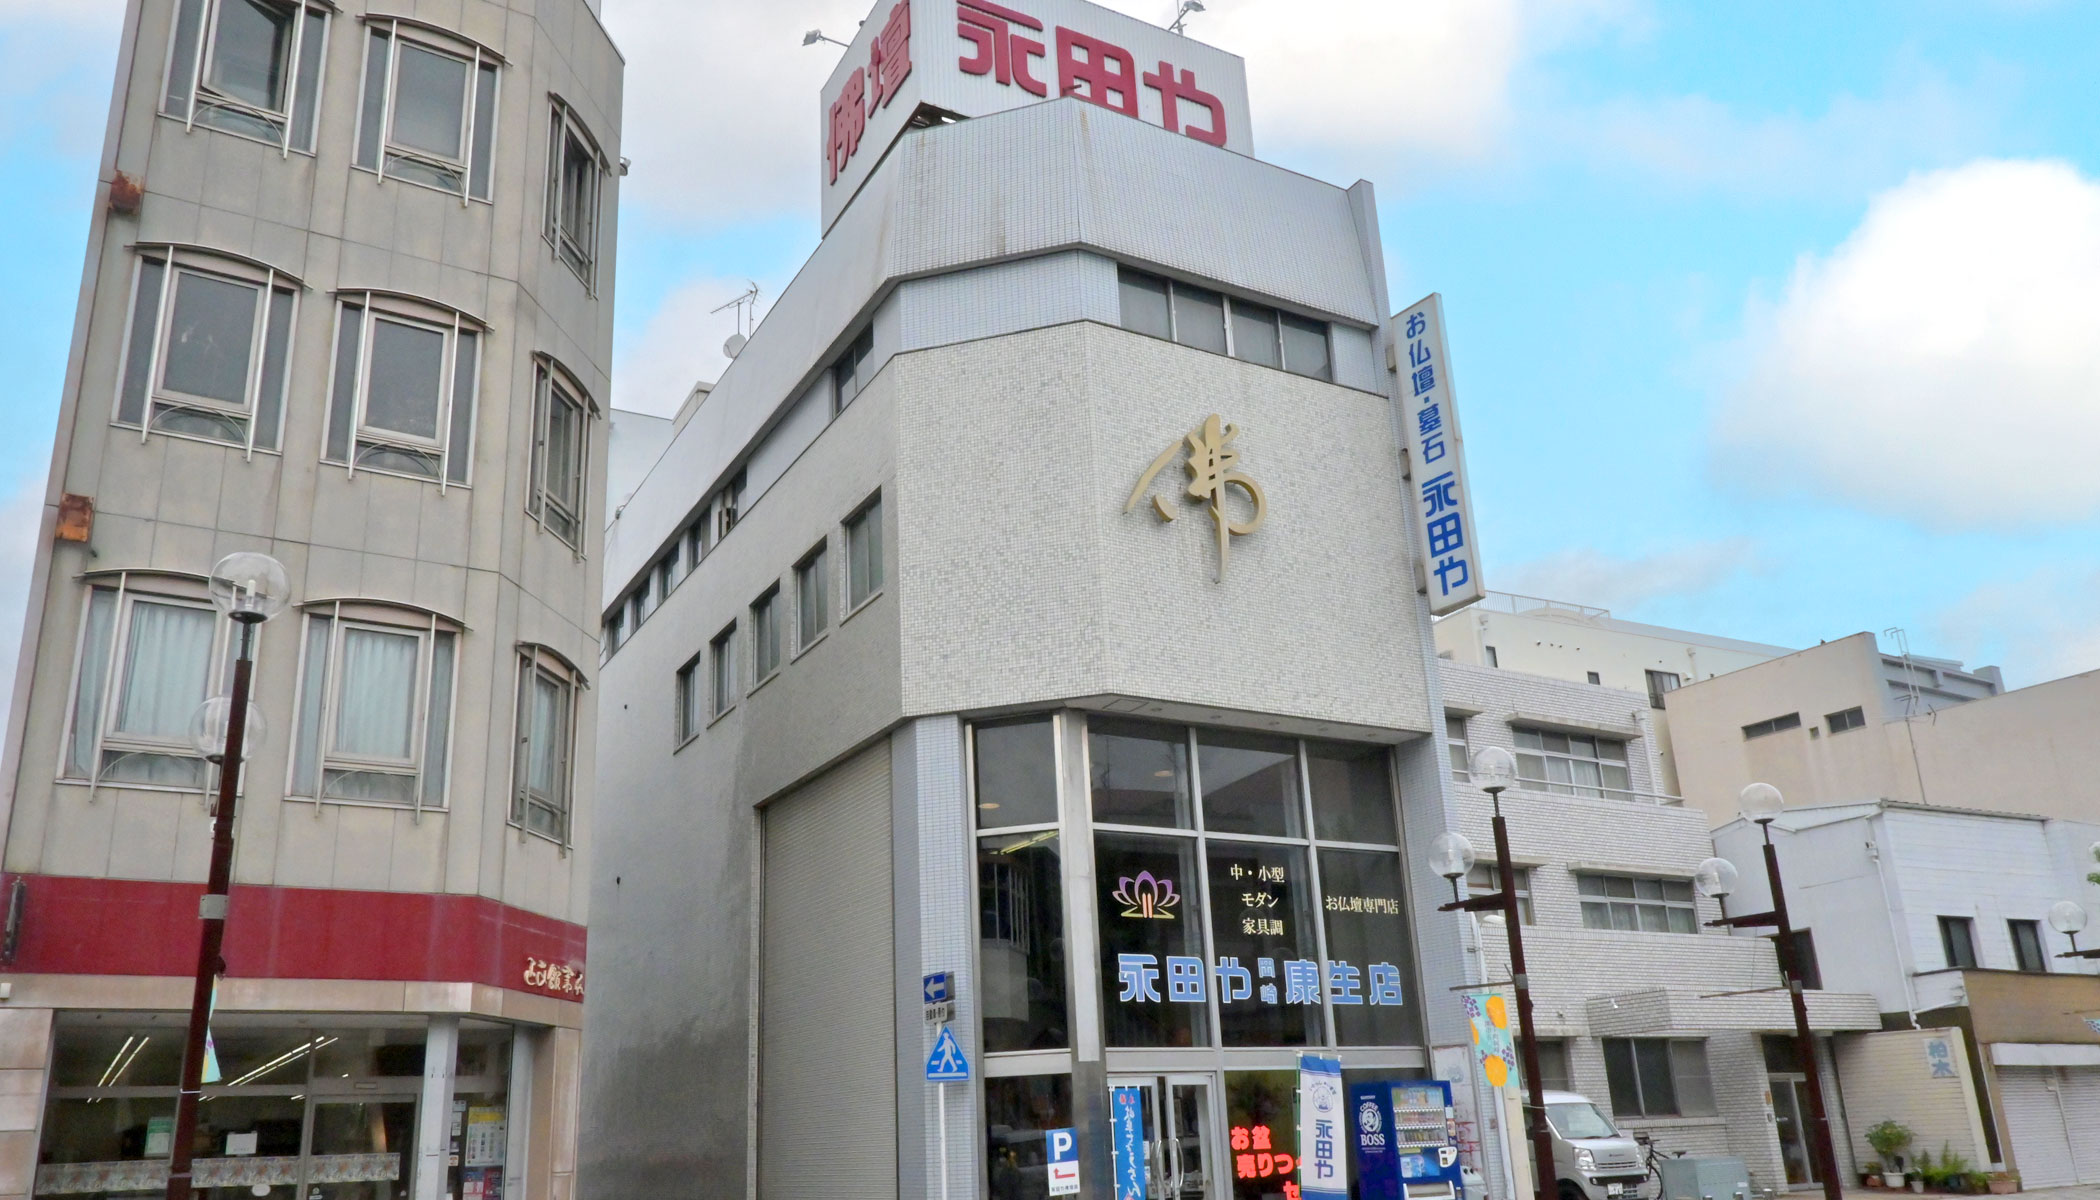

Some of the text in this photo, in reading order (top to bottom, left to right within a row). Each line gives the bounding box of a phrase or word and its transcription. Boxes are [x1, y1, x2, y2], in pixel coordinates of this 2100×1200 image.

[957, 0, 1227, 147] 永田や
[1421, 470, 1469, 596] 永田や
[1230, 864, 1285, 883] 中・小型
[1242, 892, 1279, 909] モダン
[1325, 895, 1399, 915] お仏壇専門店
[1242, 918, 1284, 936] 家具調
[1053, 1132, 1072, 1161] P
[1315, 1119, 1334, 1180] 永田や
[1360, 1133, 1386, 1146] BOSS
[1236, 1152, 1302, 1179] 売りつ
